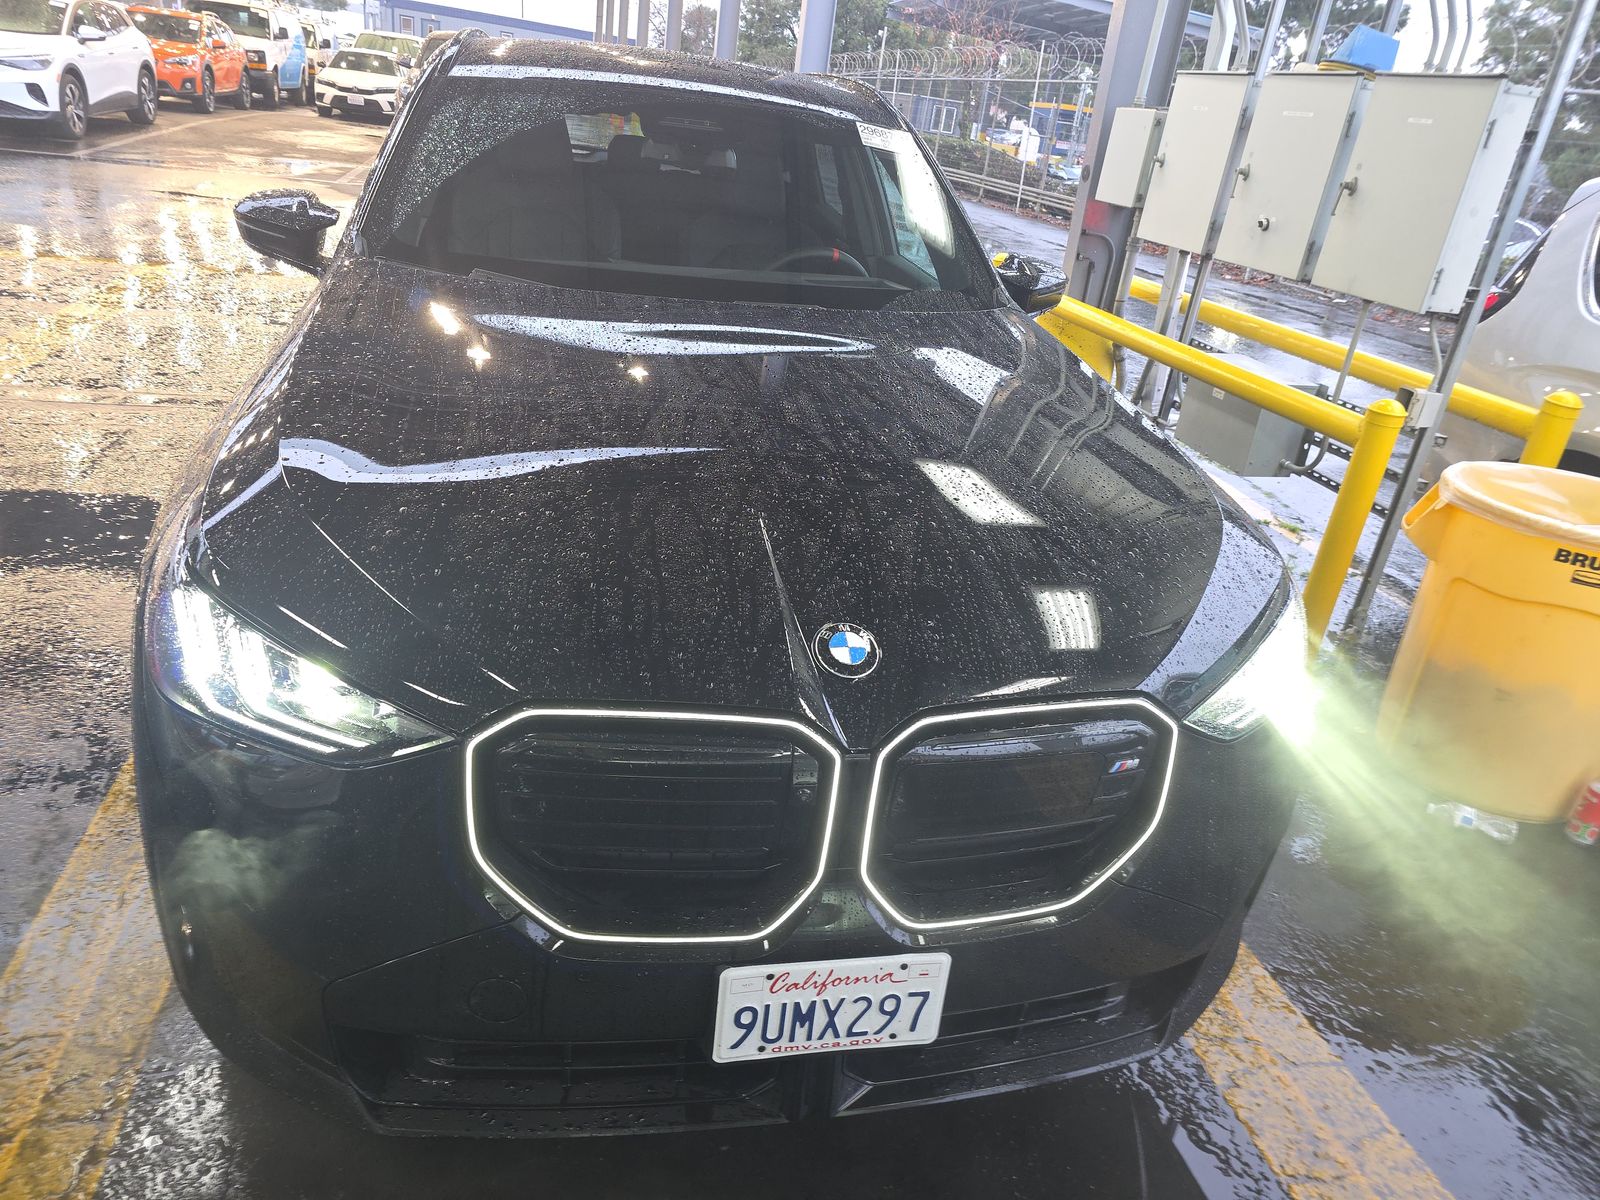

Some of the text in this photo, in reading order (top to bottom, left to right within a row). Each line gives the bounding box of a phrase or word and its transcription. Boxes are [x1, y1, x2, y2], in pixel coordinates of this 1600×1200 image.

[820, 624, 870, 642] BMW
[769, 968, 908, 996] California
[728, 991, 930, 1050] 9UMX297
[771, 1036, 884, 1054] dmv.ca.gov
